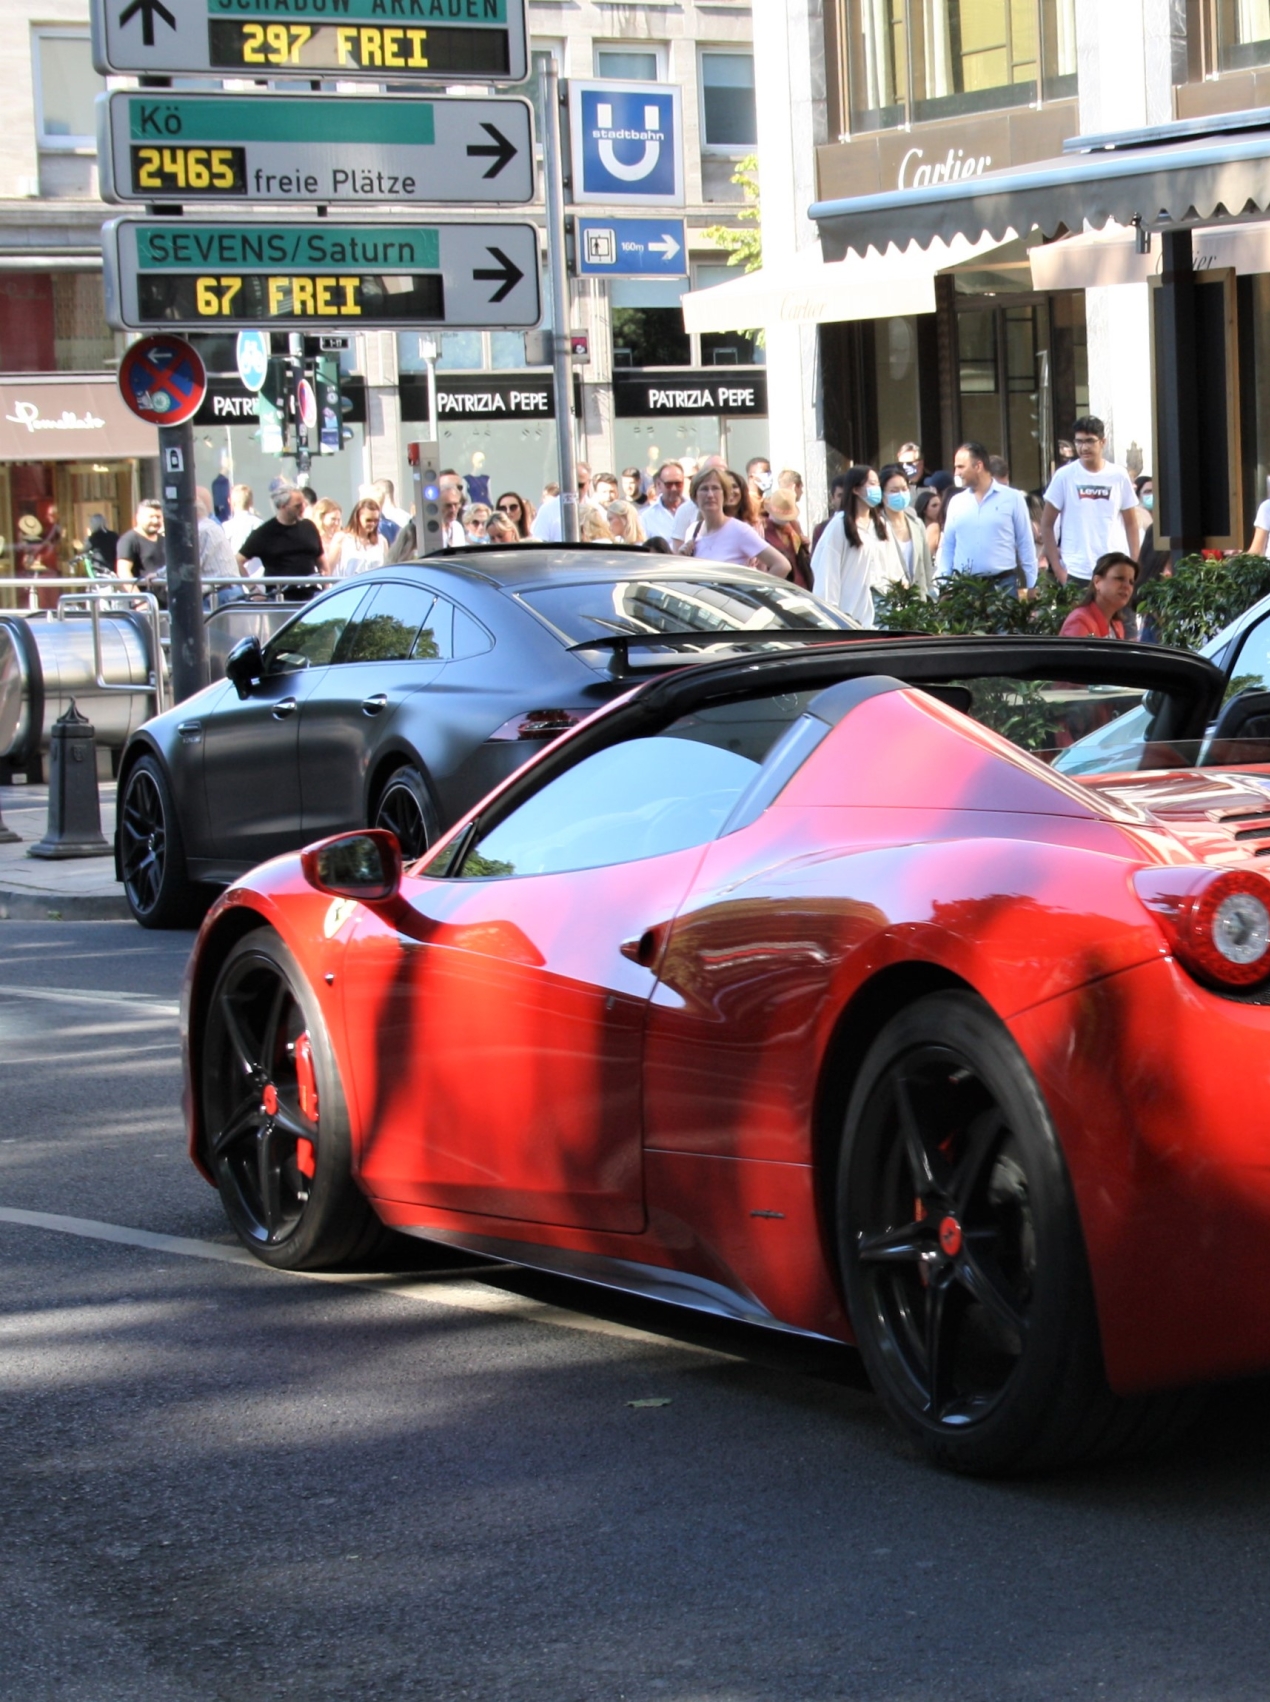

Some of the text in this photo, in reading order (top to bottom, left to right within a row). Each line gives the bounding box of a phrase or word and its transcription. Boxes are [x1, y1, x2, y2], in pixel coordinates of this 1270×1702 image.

[242, 23, 428, 67] 297 FREI
[140, 105, 182, 135] Kö
[592, 129, 665, 141] stadtbahn
[138, 149, 416, 194] 2465 freie Plätze
[898, 148, 991, 190] Cartier
[149, 234, 415, 263] SEVENS/Saturn
[621, 242, 645, 252] 160m
[196, 277, 361, 315] 67 FREI
[437, 391, 548, 412] PATRIZIA PEPE
[649, 387, 755, 408] PATRIZIA PEPE
